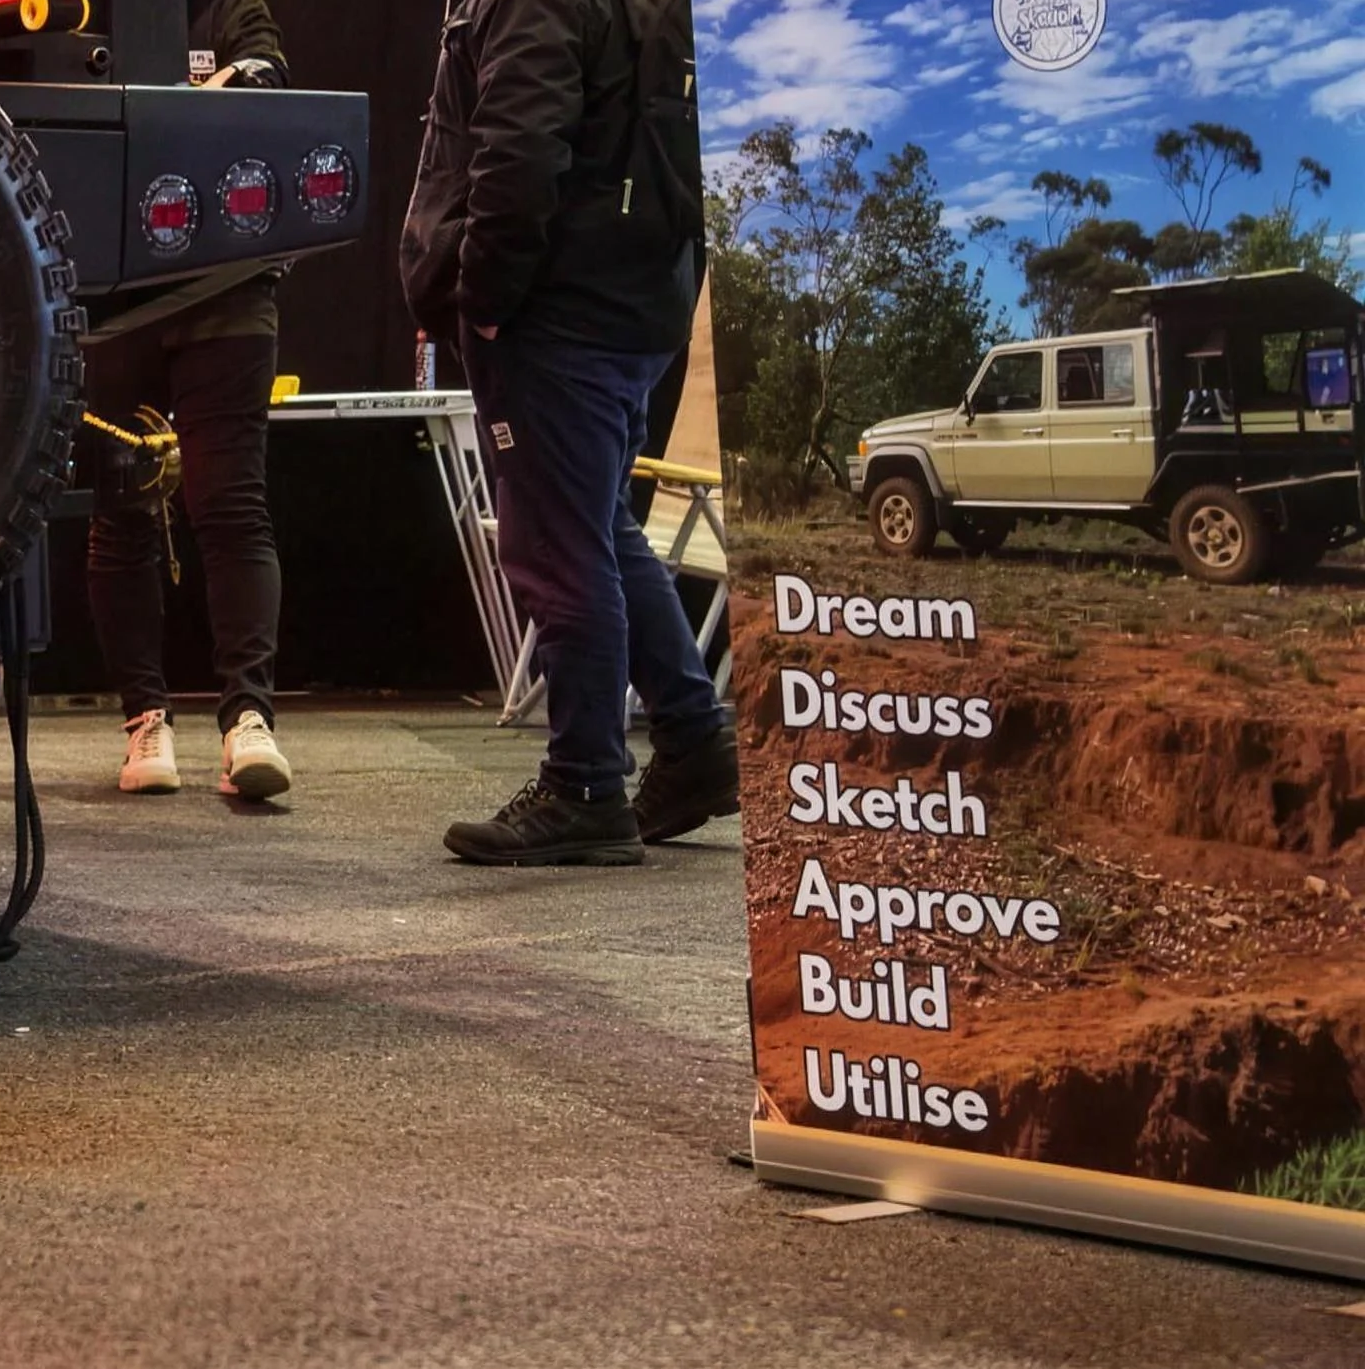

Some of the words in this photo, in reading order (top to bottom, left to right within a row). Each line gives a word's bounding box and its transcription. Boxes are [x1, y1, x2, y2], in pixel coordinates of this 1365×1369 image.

[773, 574, 979, 640] Dream
[779, 668, 994, 739] Discuss
[787, 761, 987, 837] Sketch
[791, 858, 1062, 944] Approve
[798, 953, 951, 1031] Build
[803, 1047, 989, 1132] Utilise
